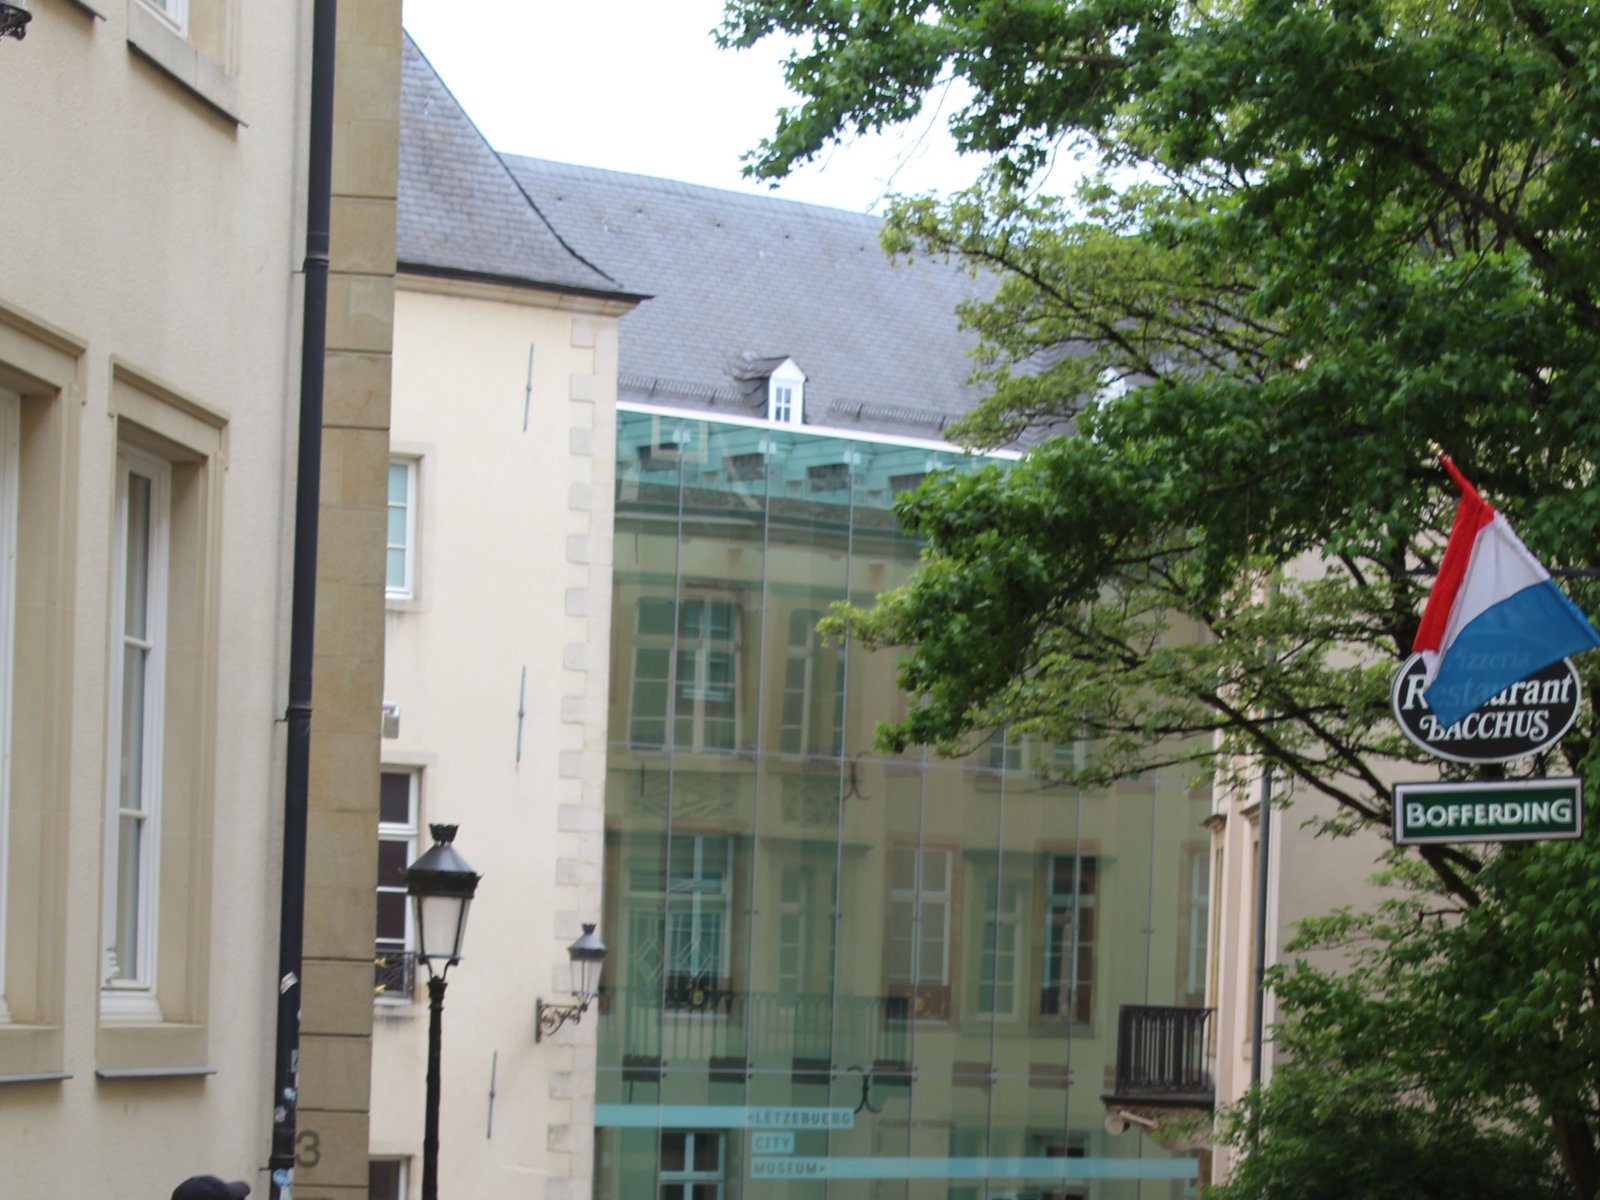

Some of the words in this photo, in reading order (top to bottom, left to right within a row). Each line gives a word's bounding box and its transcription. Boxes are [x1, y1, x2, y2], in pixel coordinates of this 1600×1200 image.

[1419, 709, 1550, 742] BACCHUS
[1406, 799, 1573, 828] BOFFERDING
[755, 1136, 791, 1149] CITY
